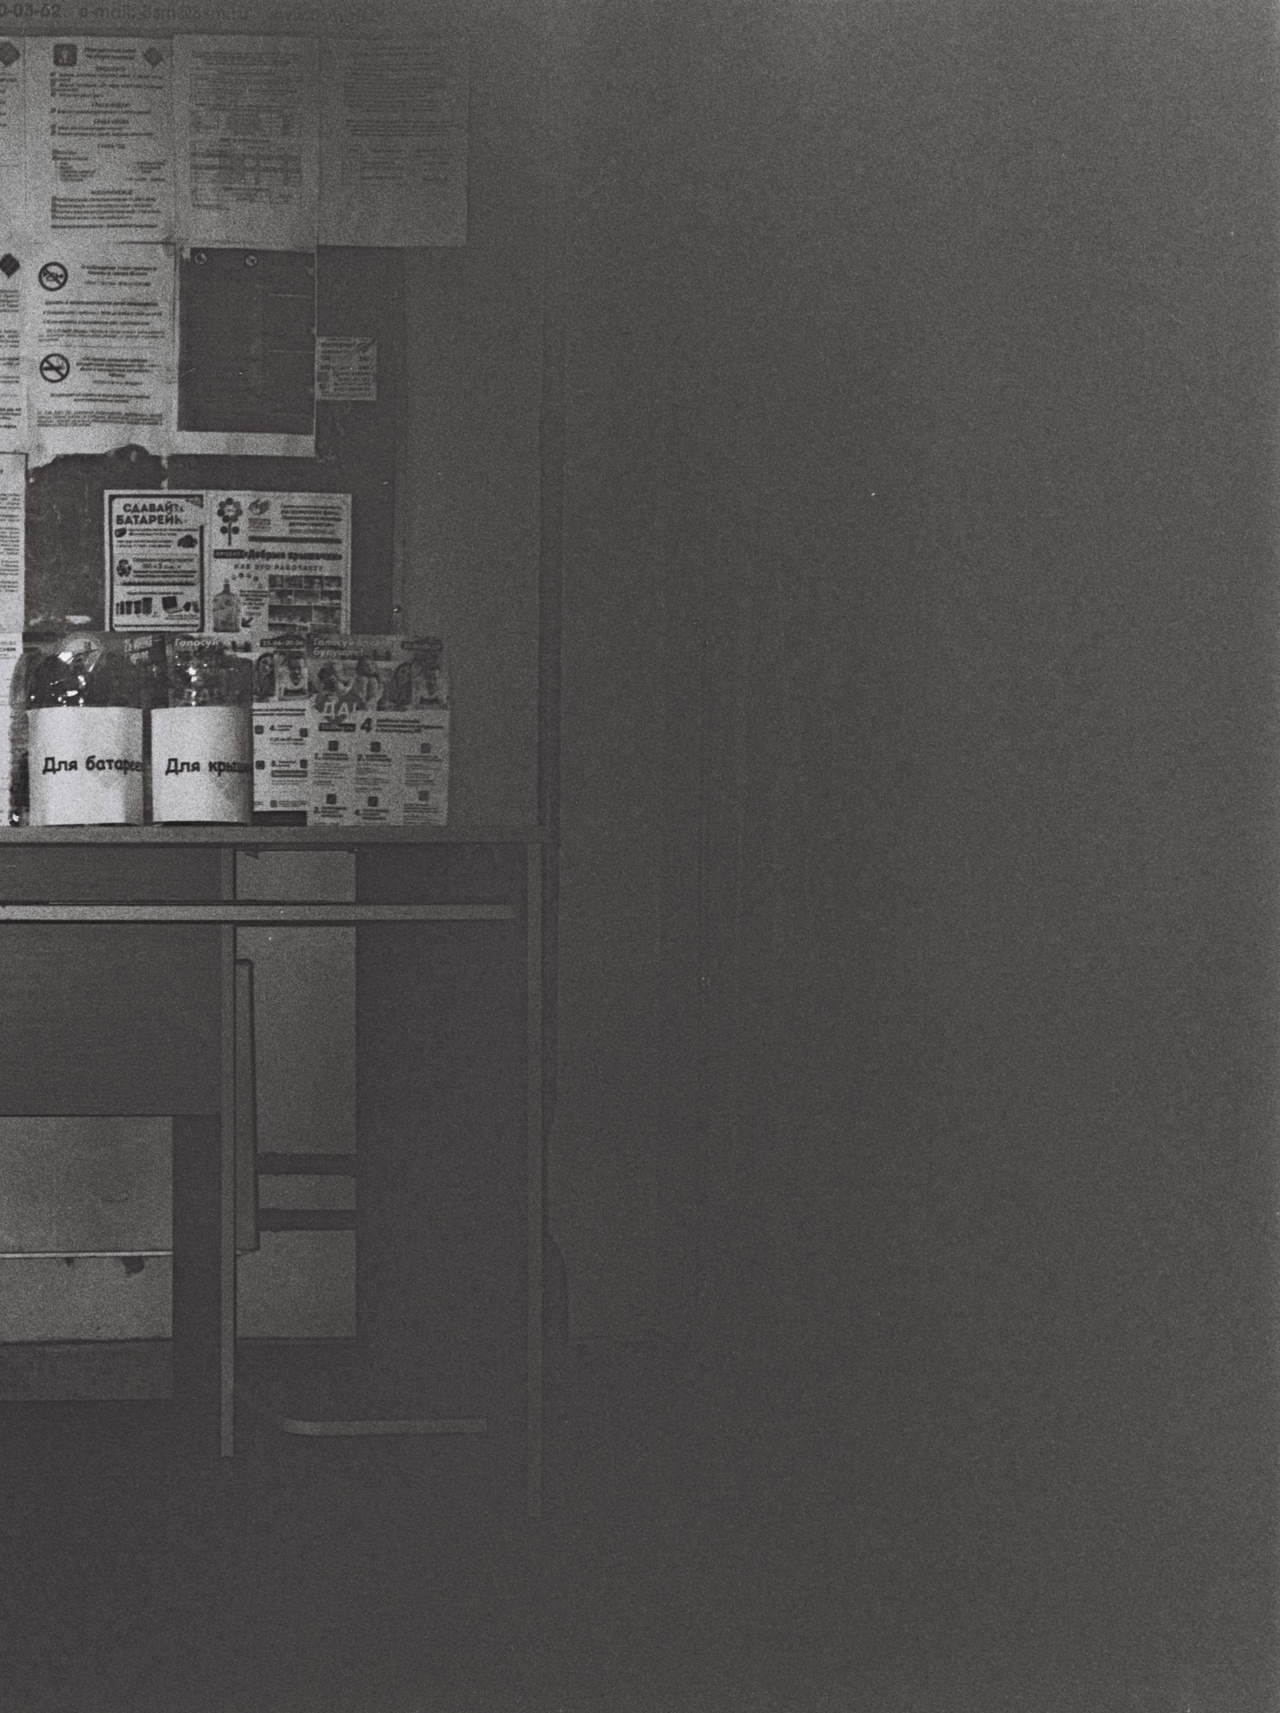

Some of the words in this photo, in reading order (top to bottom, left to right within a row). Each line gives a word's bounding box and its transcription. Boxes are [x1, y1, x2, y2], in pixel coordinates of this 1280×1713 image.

[115, 511, 184, 525] БАТАРЕЙК
[42, 756, 78, 776] Для
[165, 757, 201, 777] Для
